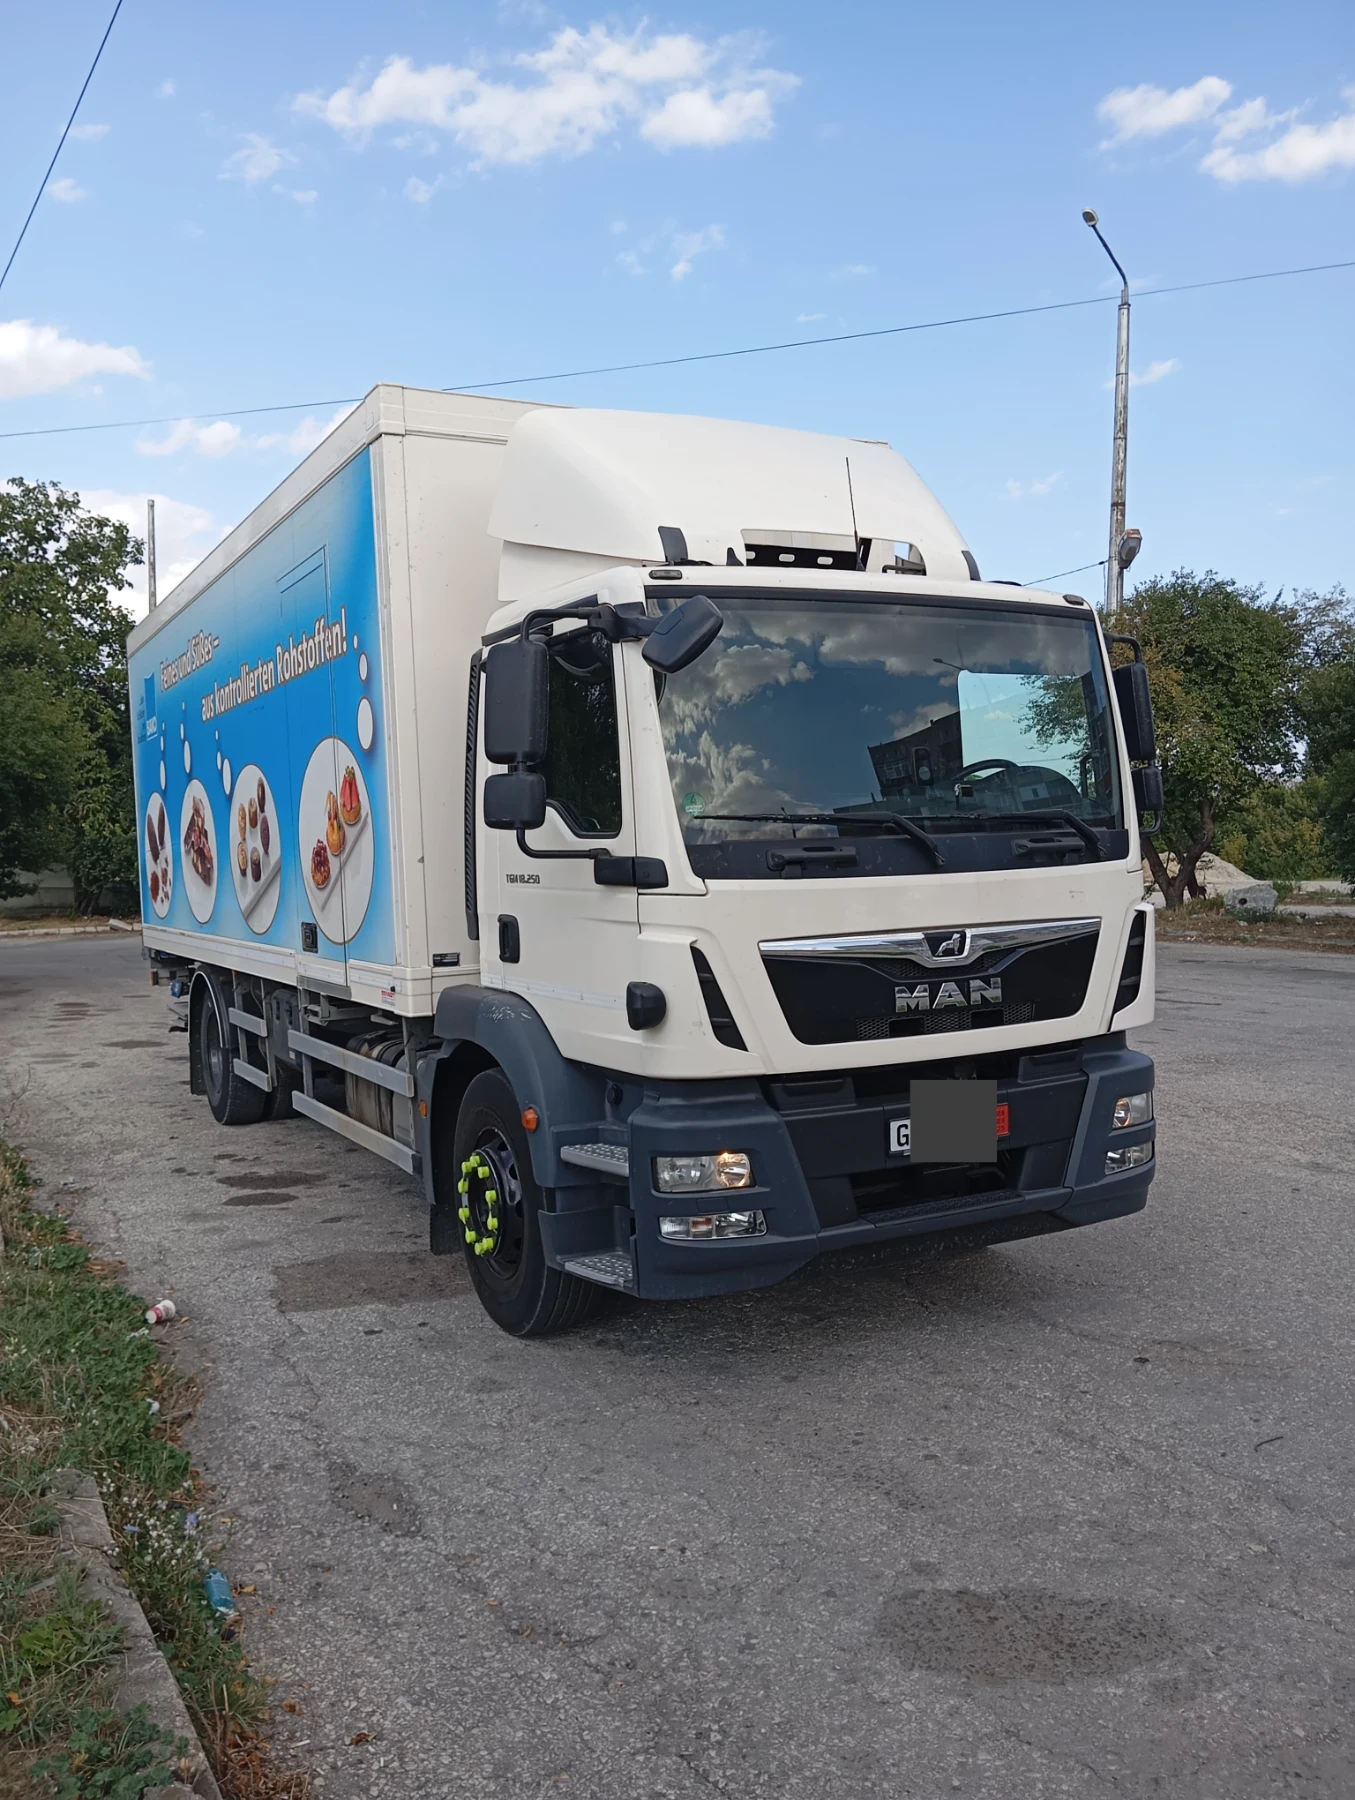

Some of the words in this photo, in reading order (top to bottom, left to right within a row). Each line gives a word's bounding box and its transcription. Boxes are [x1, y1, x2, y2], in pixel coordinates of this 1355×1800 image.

[179, 639, 191, 680] und
[201, 692, 215, 722] aus
[214, 657, 275, 716] kontrollierten
[276, 605, 347, 687] Rohstoffen!
[894, 977, 1003, 1013] MAN
